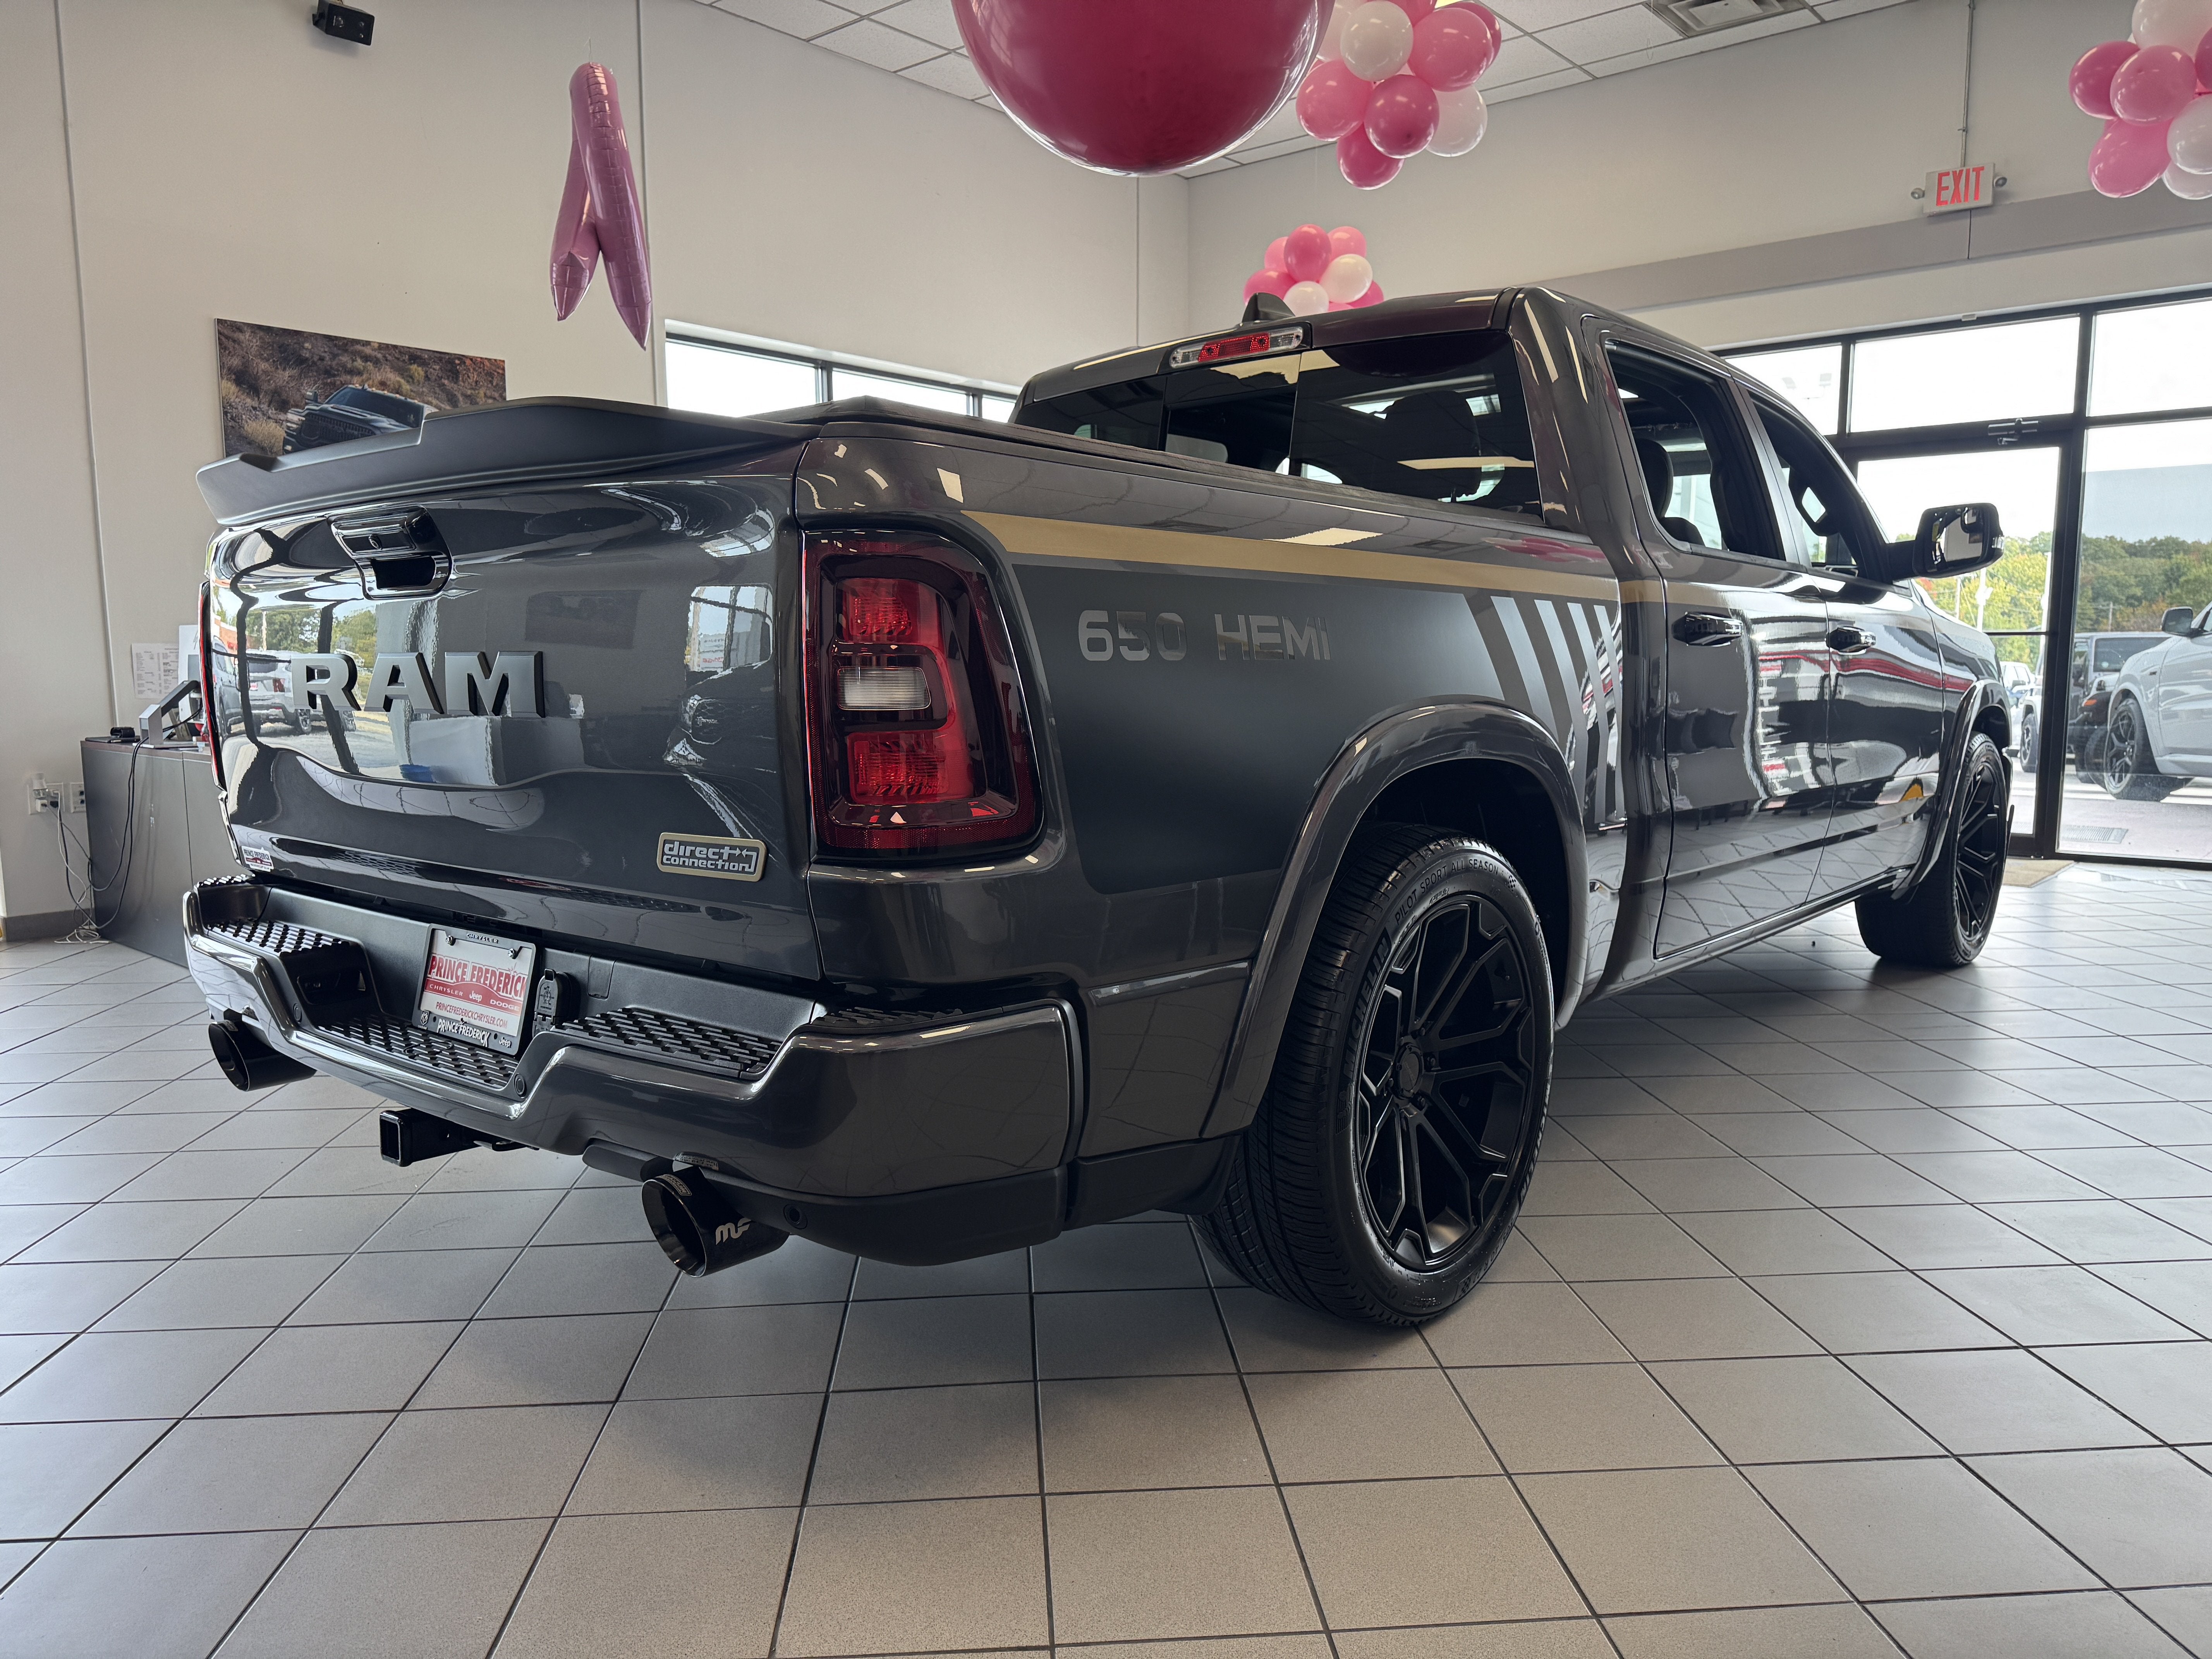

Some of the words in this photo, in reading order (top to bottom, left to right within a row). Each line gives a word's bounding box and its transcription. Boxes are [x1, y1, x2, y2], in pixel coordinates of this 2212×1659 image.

[1936, 166, 1985, 206] EXIT
[1078, 610, 1187, 661] 650
[1214, 614, 1331, 661] HEMI
[291, 651, 545, 718] RAM
[663, 855, 755, 872] connection
[664, 841, 735, 860] direct
[1395, 889, 1417, 925] PILOT
[1420, 865, 1447, 893] SPORT
[1451, 860, 1465, 873] ALL
[1469, 859, 1499, 874] SEASON
[466, 933, 499, 944] CHRYSLER
[428, 955, 468, 983] PRINCE
[471, 964, 527, 998] FREDERICK
[429, 984, 463, 997] CHRYSLER
[469, 990, 482, 1003] Jeep
[490, 1000, 520, 1012] DODGE
[1343, 937, 1389, 1079] MICHELIN
[436, 1002, 508, 1029] PRINCEFREDERICKCHRYSLER.COM
[437, 1018, 458, 1033] PRINCE
[459, 1024, 490, 1047] FREDERICK
[499, 1037, 512, 1048] Jeep
